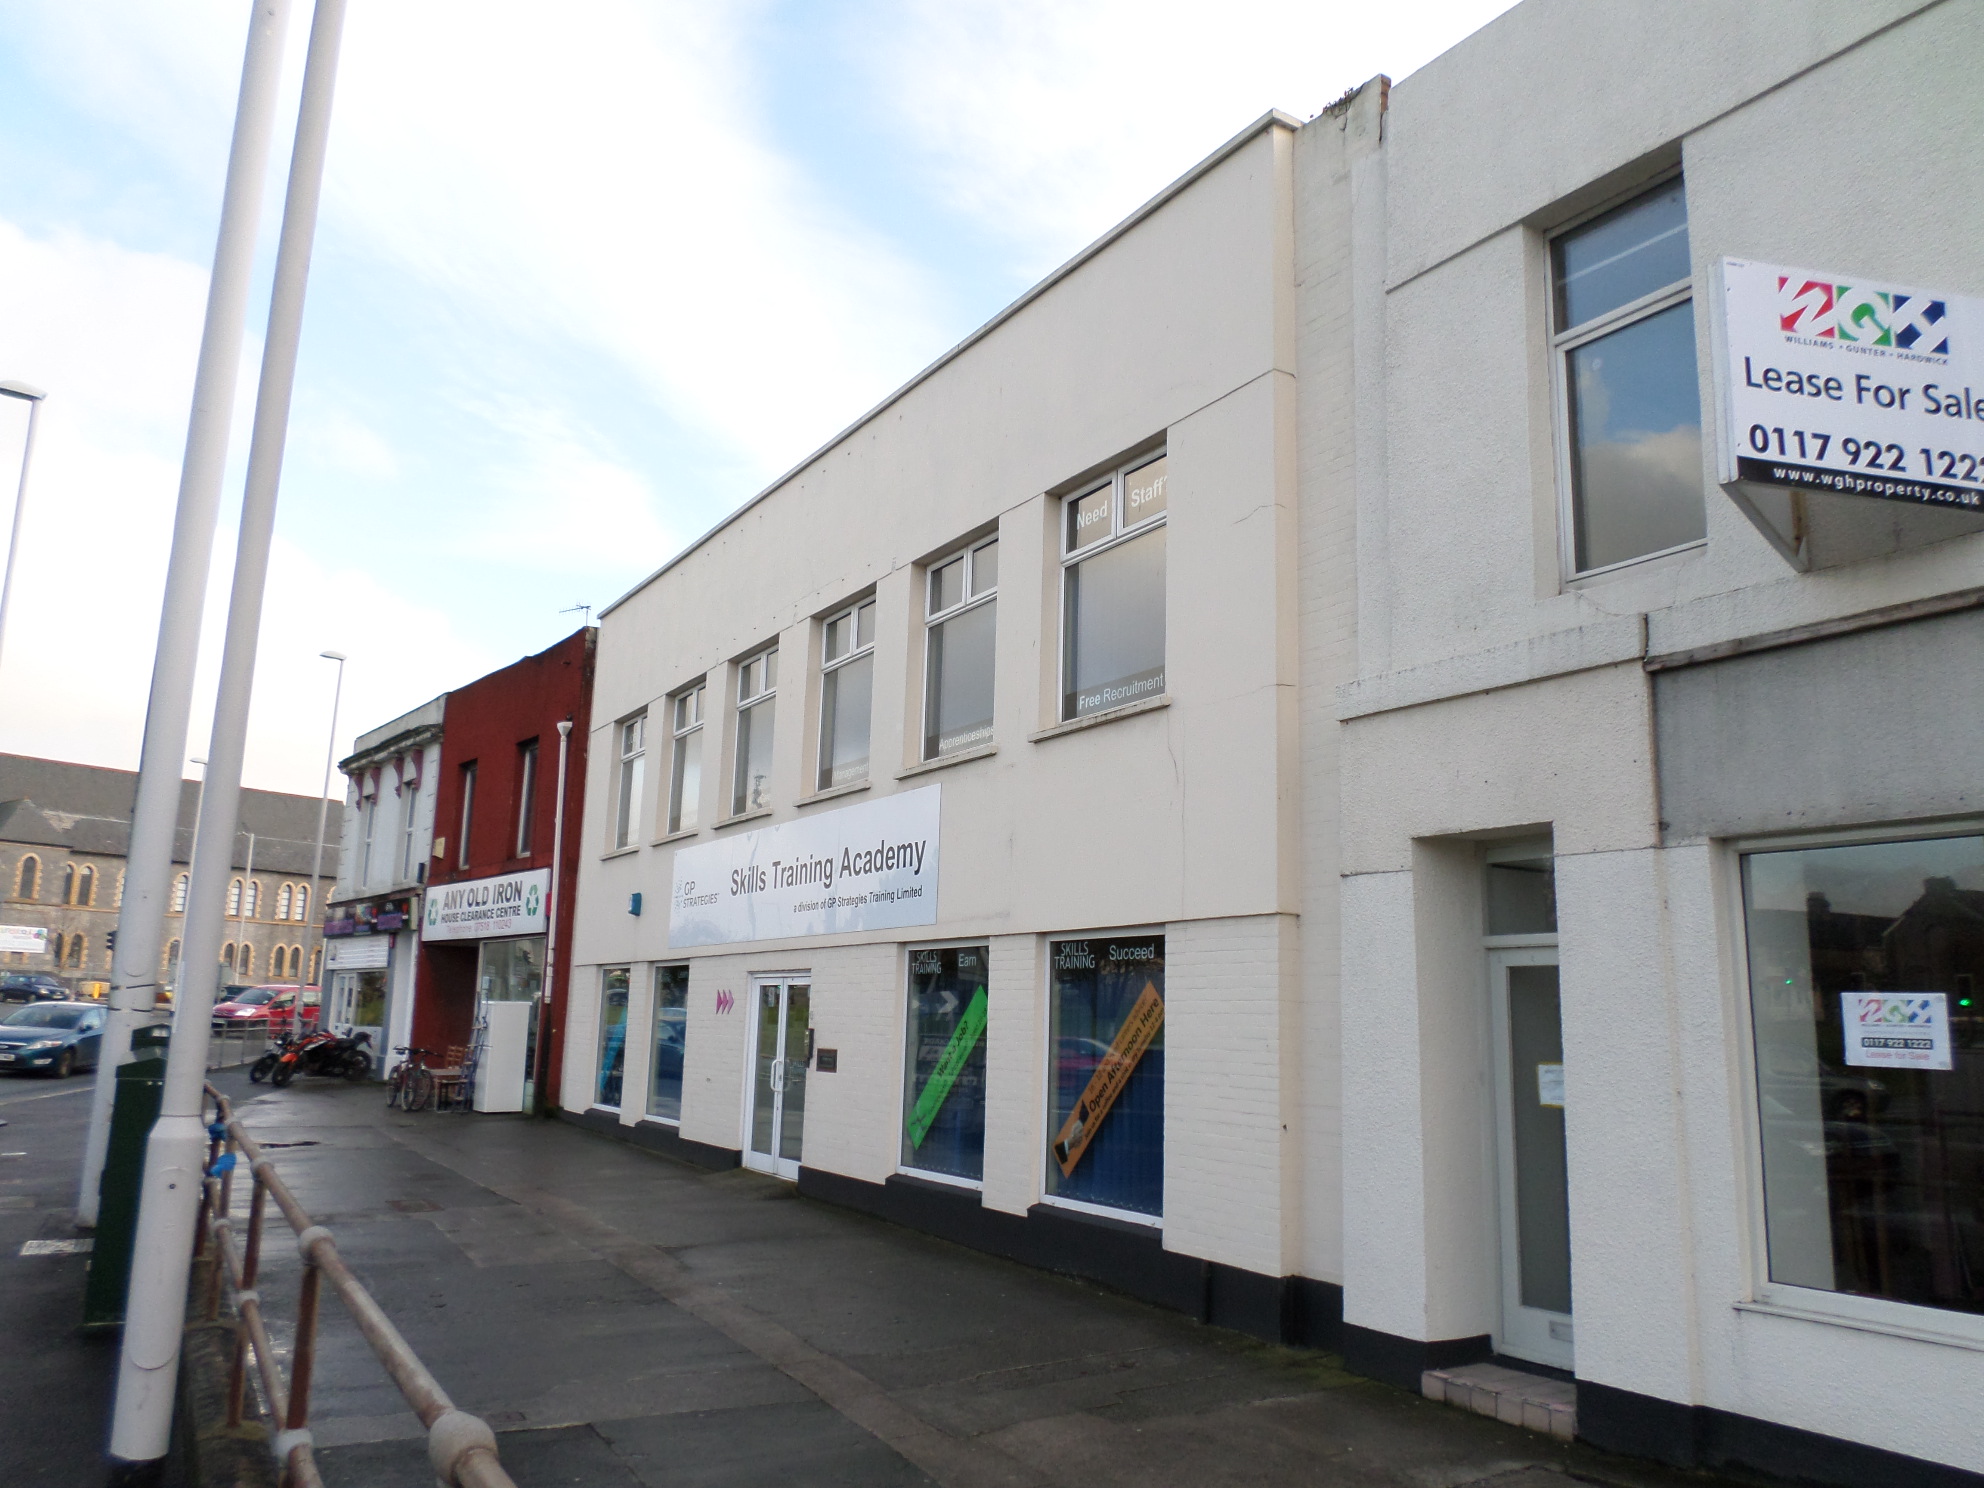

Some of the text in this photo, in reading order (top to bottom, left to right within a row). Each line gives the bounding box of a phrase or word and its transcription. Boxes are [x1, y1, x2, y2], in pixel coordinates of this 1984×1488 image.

[1784, 335, 1948, 365] WILLIAMS GUNTER HARDWICK
[1744, 356, 1984, 421] Lease For Sale
[1749, 423, 1984, 483] 0117 922 122
[1773, 467, 1980, 506] www.wghproperty.co.uk
[1076, 501, 1108, 531] Need
[1078, 673, 1164, 710] Free Recruitment
[938, 725, 994, 752] Apprenticeships
[834, 763, 869, 780] Management
[730, 839, 927, 897] Skills Training Academy
[442, 880, 523, 911] ANY OLD IRON
[682, 892, 718, 909] STRATEGIES
[684, 881, 696, 896] GP
[793, 884, 923, 913] a division of GP Strategies Training Limited
[440, 904, 522, 924] HOUSE CLEARANCE CENTRE
[916, 950, 937, 963] SKILLS
[1054, 954, 1096, 970] TRAINING
[1061, 941, 1089, 956] SKILLS
[1109, 943, 1155, 961] Succeed
[911, 962, 942, 975] TRAINING
[937, 1052, 952, 1077] Want
[956, 1020, 969, 1046] Job?
[1089, 1082, 1109, 1112] Open
[1107, 1026, 1142, 1084] Afternoon
[1139, 998, 1159, 1028] Here
[1863, 1038, 1931, 1049] 0117 922 1222
